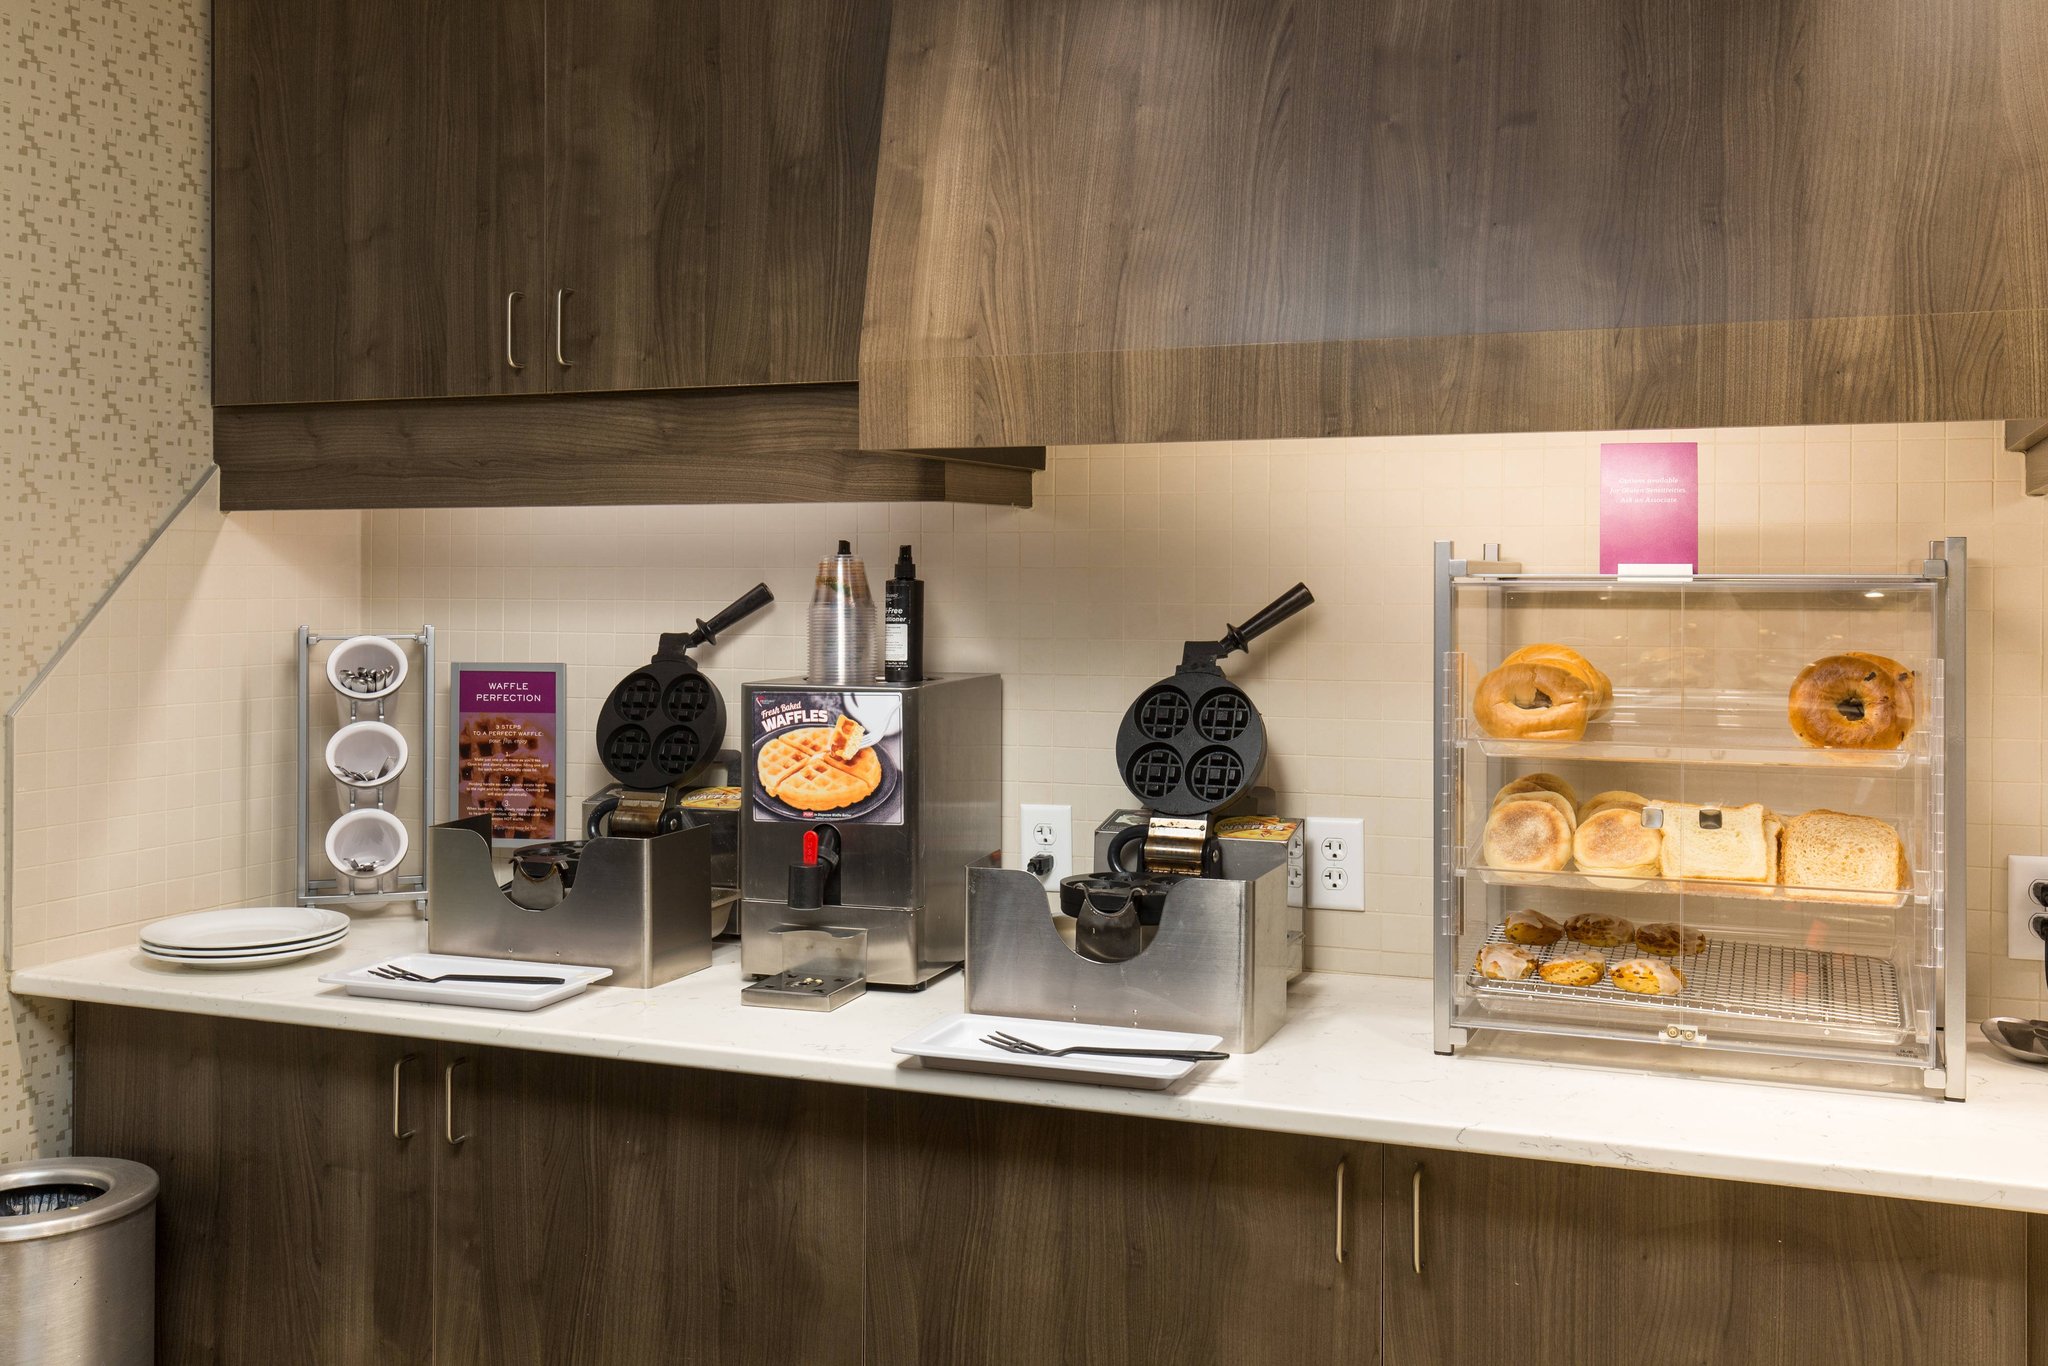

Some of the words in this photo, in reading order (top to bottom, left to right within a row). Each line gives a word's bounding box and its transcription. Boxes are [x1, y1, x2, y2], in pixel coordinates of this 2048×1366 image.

[488, 682, 529, 691] WAFFLE
[476, 693, 541, 702] PERFECTION
[761, 706, 780, 719] Fresh
[780, 701, 802, 713] Baked
[761, 709, 828, 733] WAFFLES
